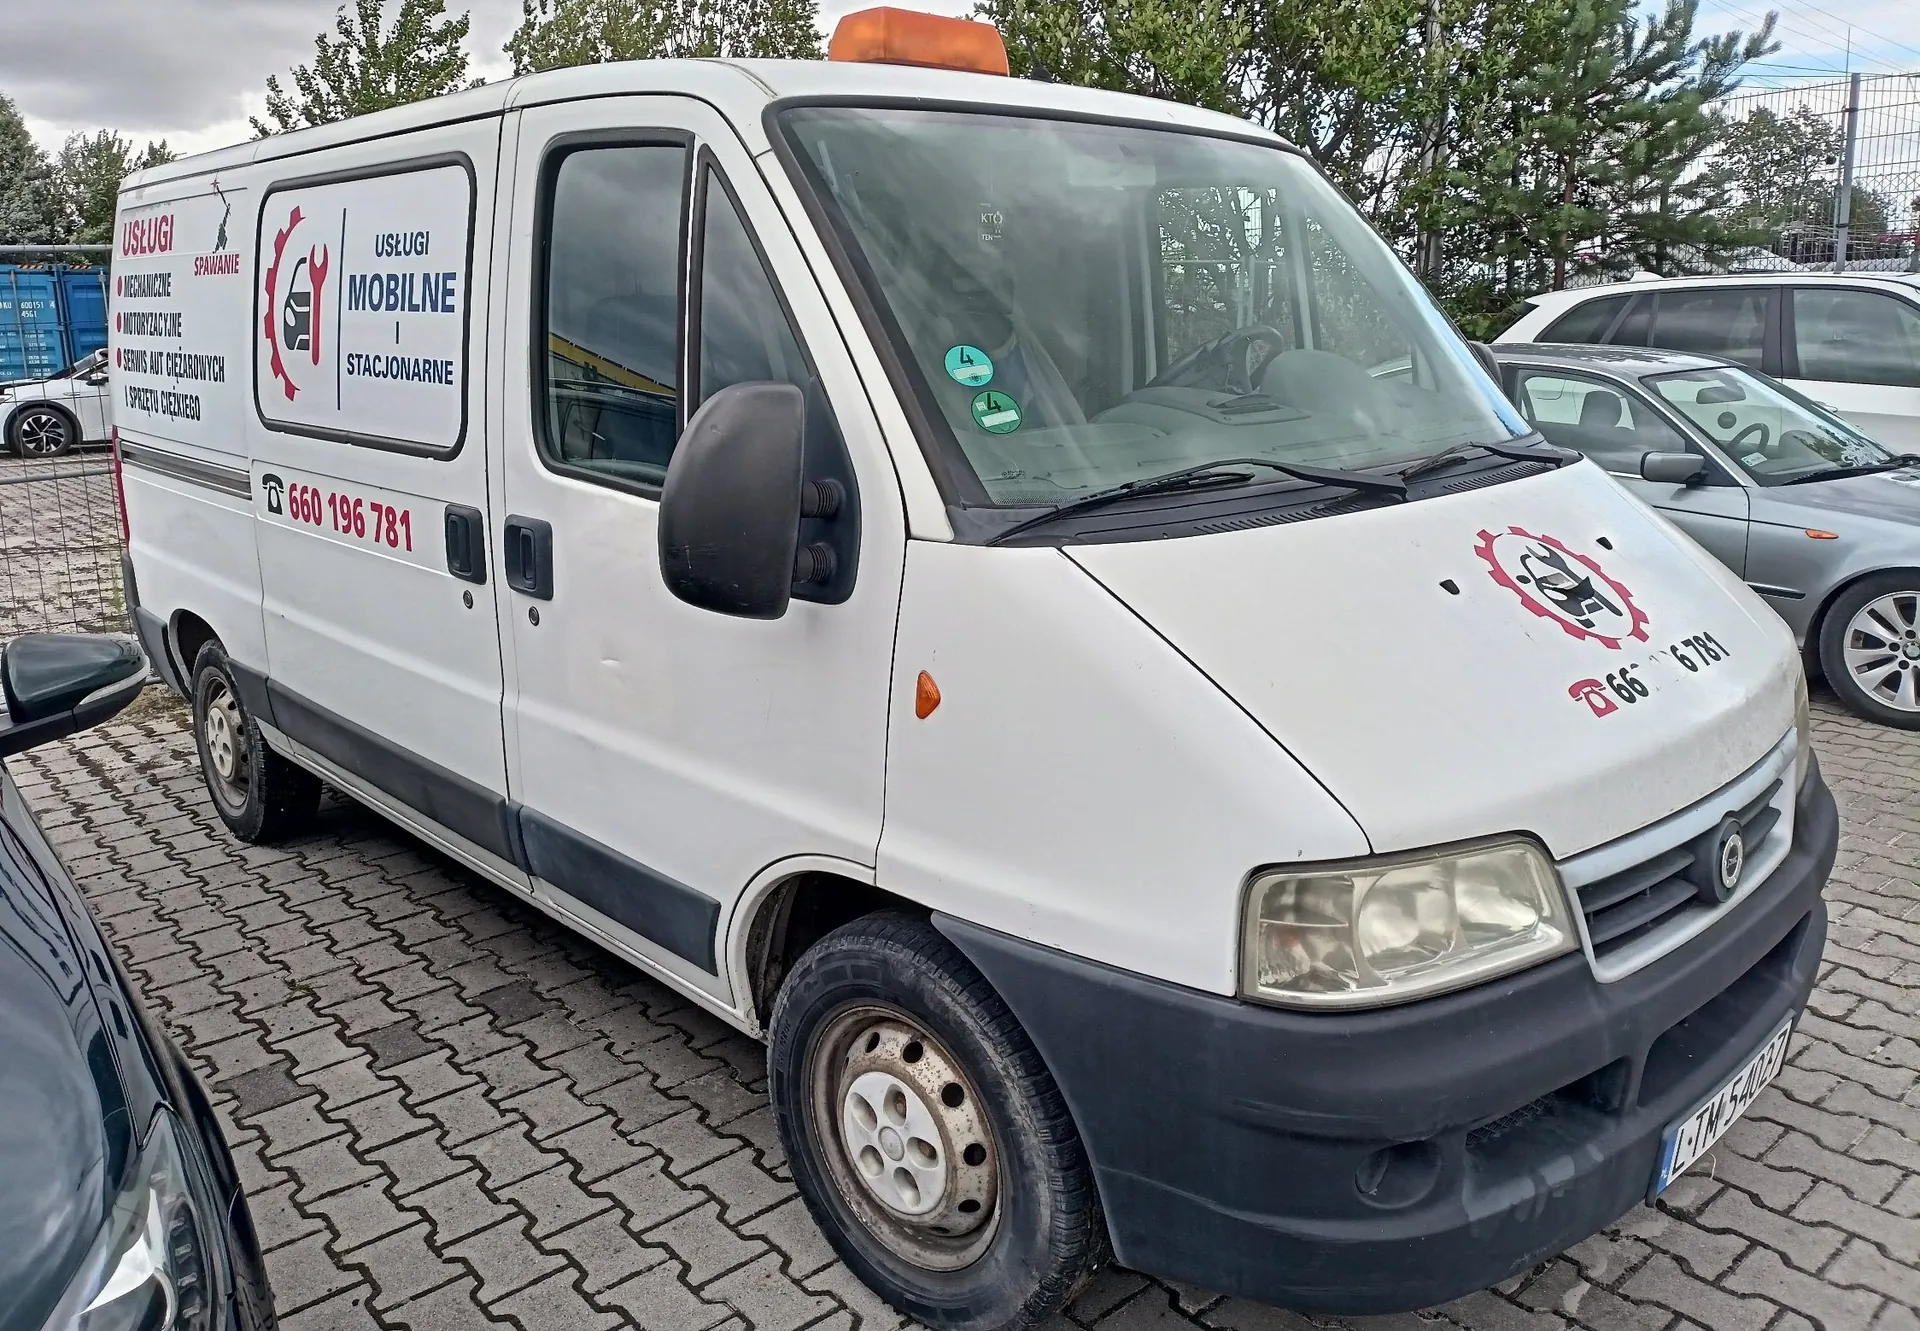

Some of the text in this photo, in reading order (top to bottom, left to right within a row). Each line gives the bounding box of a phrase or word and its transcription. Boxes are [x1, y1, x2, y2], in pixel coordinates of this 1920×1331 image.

[122, 214, 174, 256] USŁUGI
[375, 231, 430, 258] USŁUGI
[194, 253, 240, 277] SPAWANIE
[123, 273, 172, 299] MECHANICZNE
[348, 272, 457, 313] MOBILNE
[123, 312, 182, 338] MOTORYZACYJNE
[396, 321, 399, 344] I
[123, 346, 225, 384] SERWIS AUT CIĘŻAROWYCH
[346, 352, 454, 386] STACJONARNE
[960, 346, 975, 366] 4
[125, 385, 201, 422] I SPRZĘTU CIĘŻKIEGO
[987, 392, 1001, 412] 4
[289, 483, 412, 552] 660 196 781
